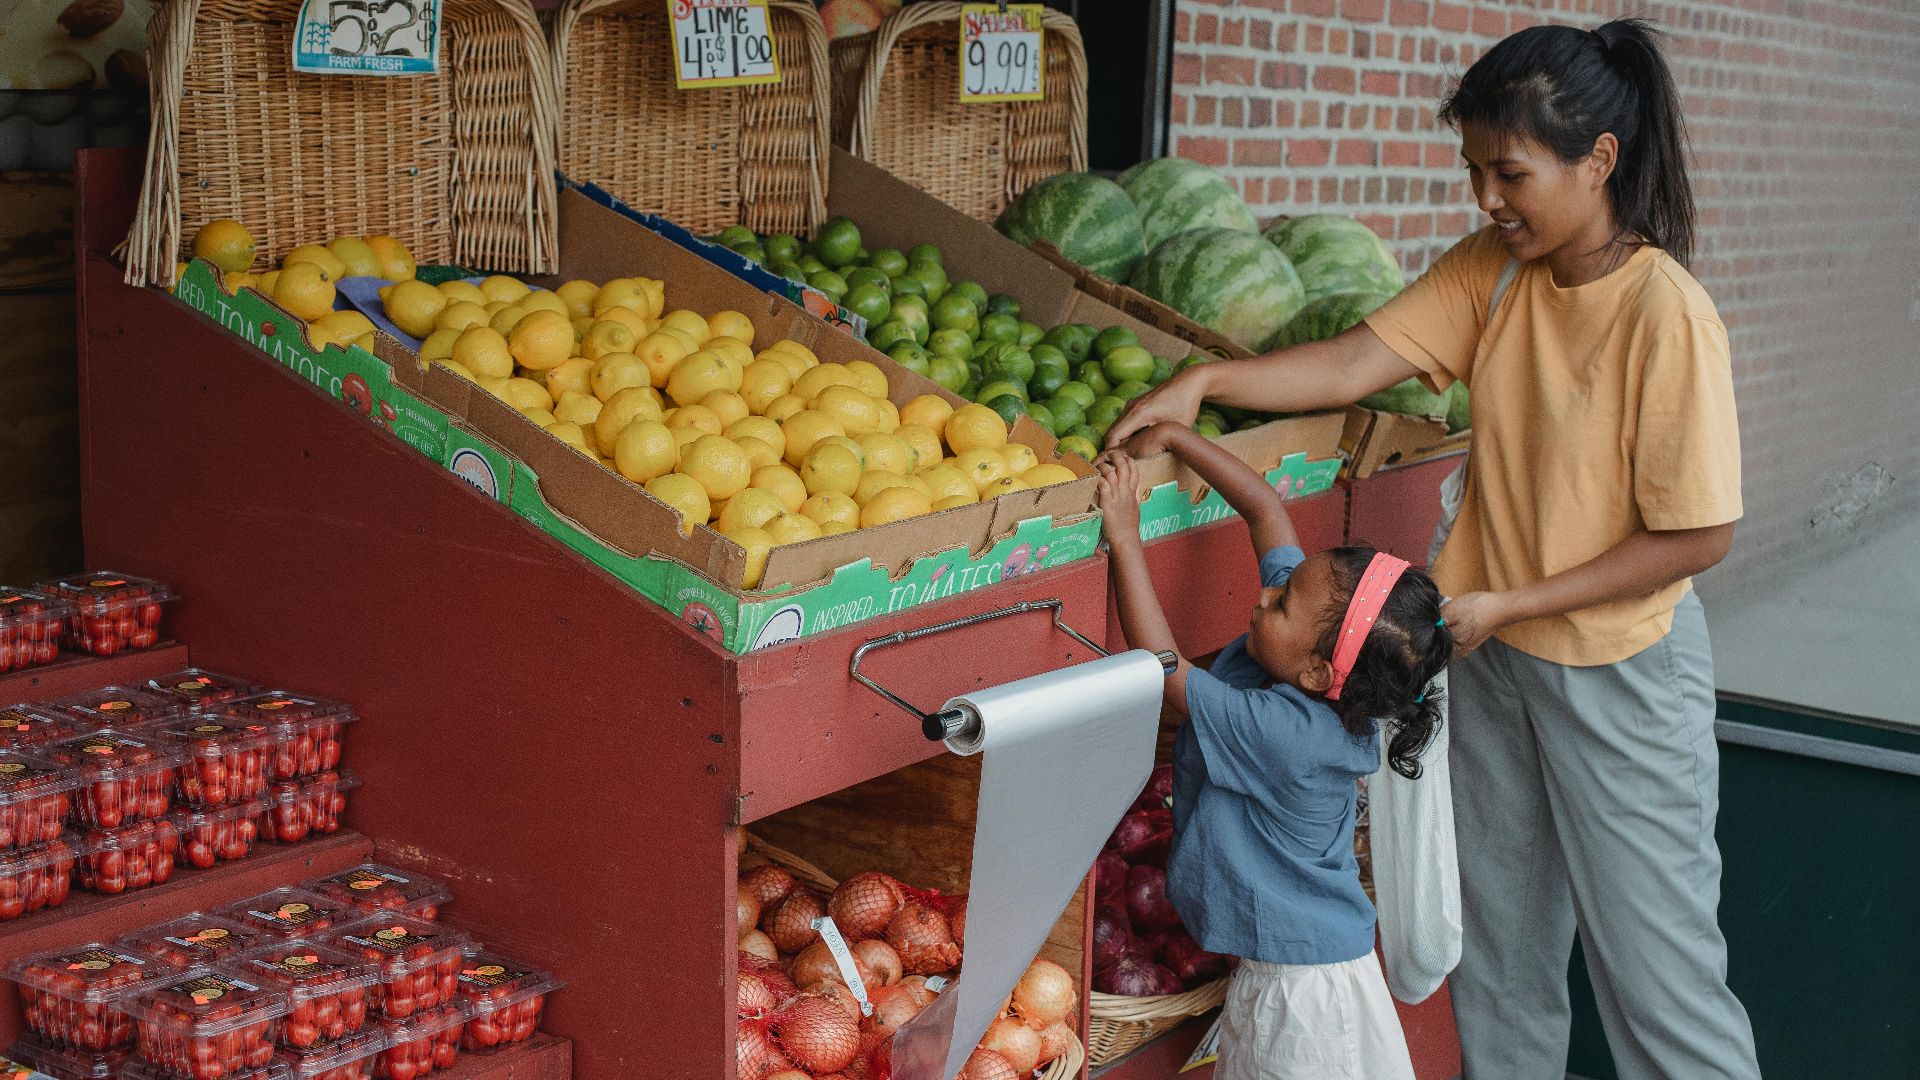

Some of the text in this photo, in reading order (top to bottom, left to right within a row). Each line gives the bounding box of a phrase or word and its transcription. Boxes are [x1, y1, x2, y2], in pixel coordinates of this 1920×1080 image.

[693, 7, 749, 34] LIME
[328, 55, 404, 71] FARM FRESH
[685, 36, 703, 77] 4
[967, 40, 1028, 94] 9.99
[1138, 514, 1180, 542] NSPIRED
